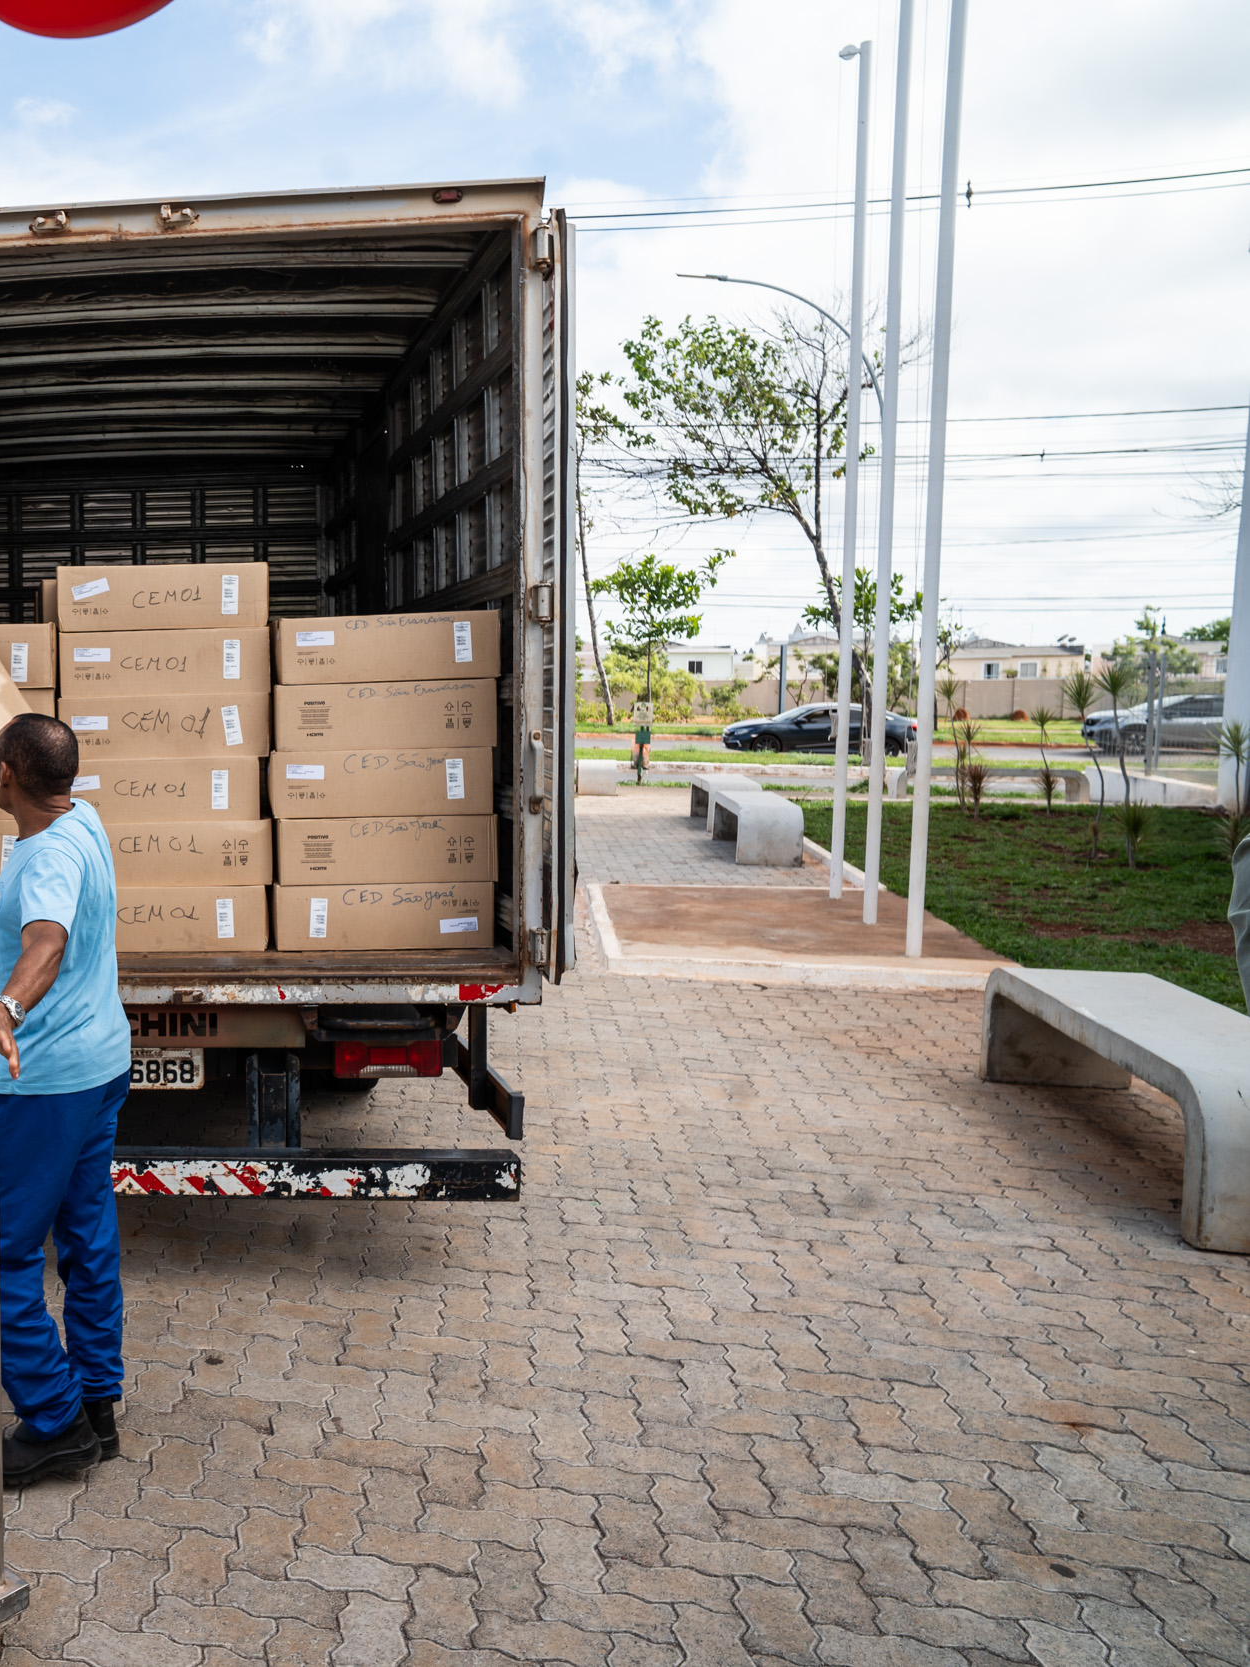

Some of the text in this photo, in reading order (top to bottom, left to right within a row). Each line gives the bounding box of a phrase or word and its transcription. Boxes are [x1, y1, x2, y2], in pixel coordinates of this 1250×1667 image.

[343, 753, 389, 774] CED
[350, 819, 384, 838] CED
[343, 885, 456, 910] CED São José
[129, 1059, 195, 1084] 6868
